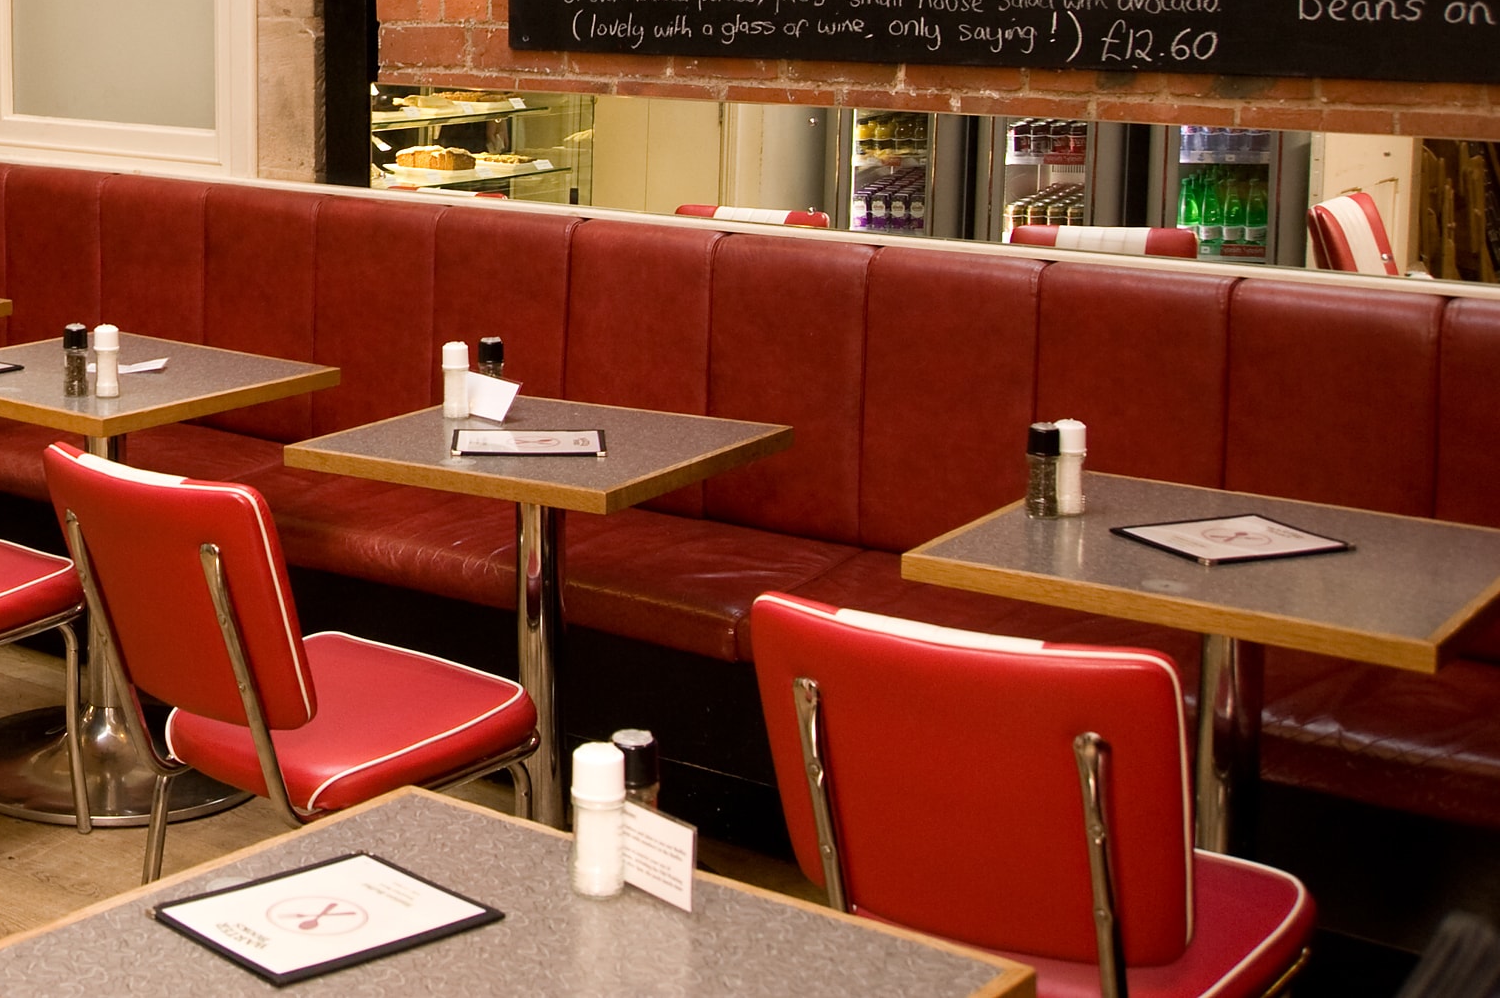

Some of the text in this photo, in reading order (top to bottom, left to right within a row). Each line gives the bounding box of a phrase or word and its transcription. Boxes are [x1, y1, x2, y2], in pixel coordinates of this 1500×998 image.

[1443, 0, 1498, 25] on
[653, 14, 693, 38] with
[720, 14, 777, 45] glass
[783, 17, 809, 39] of
[887, 16, 942, 51] only
[1100, 18, 1220, 63] £12.60
